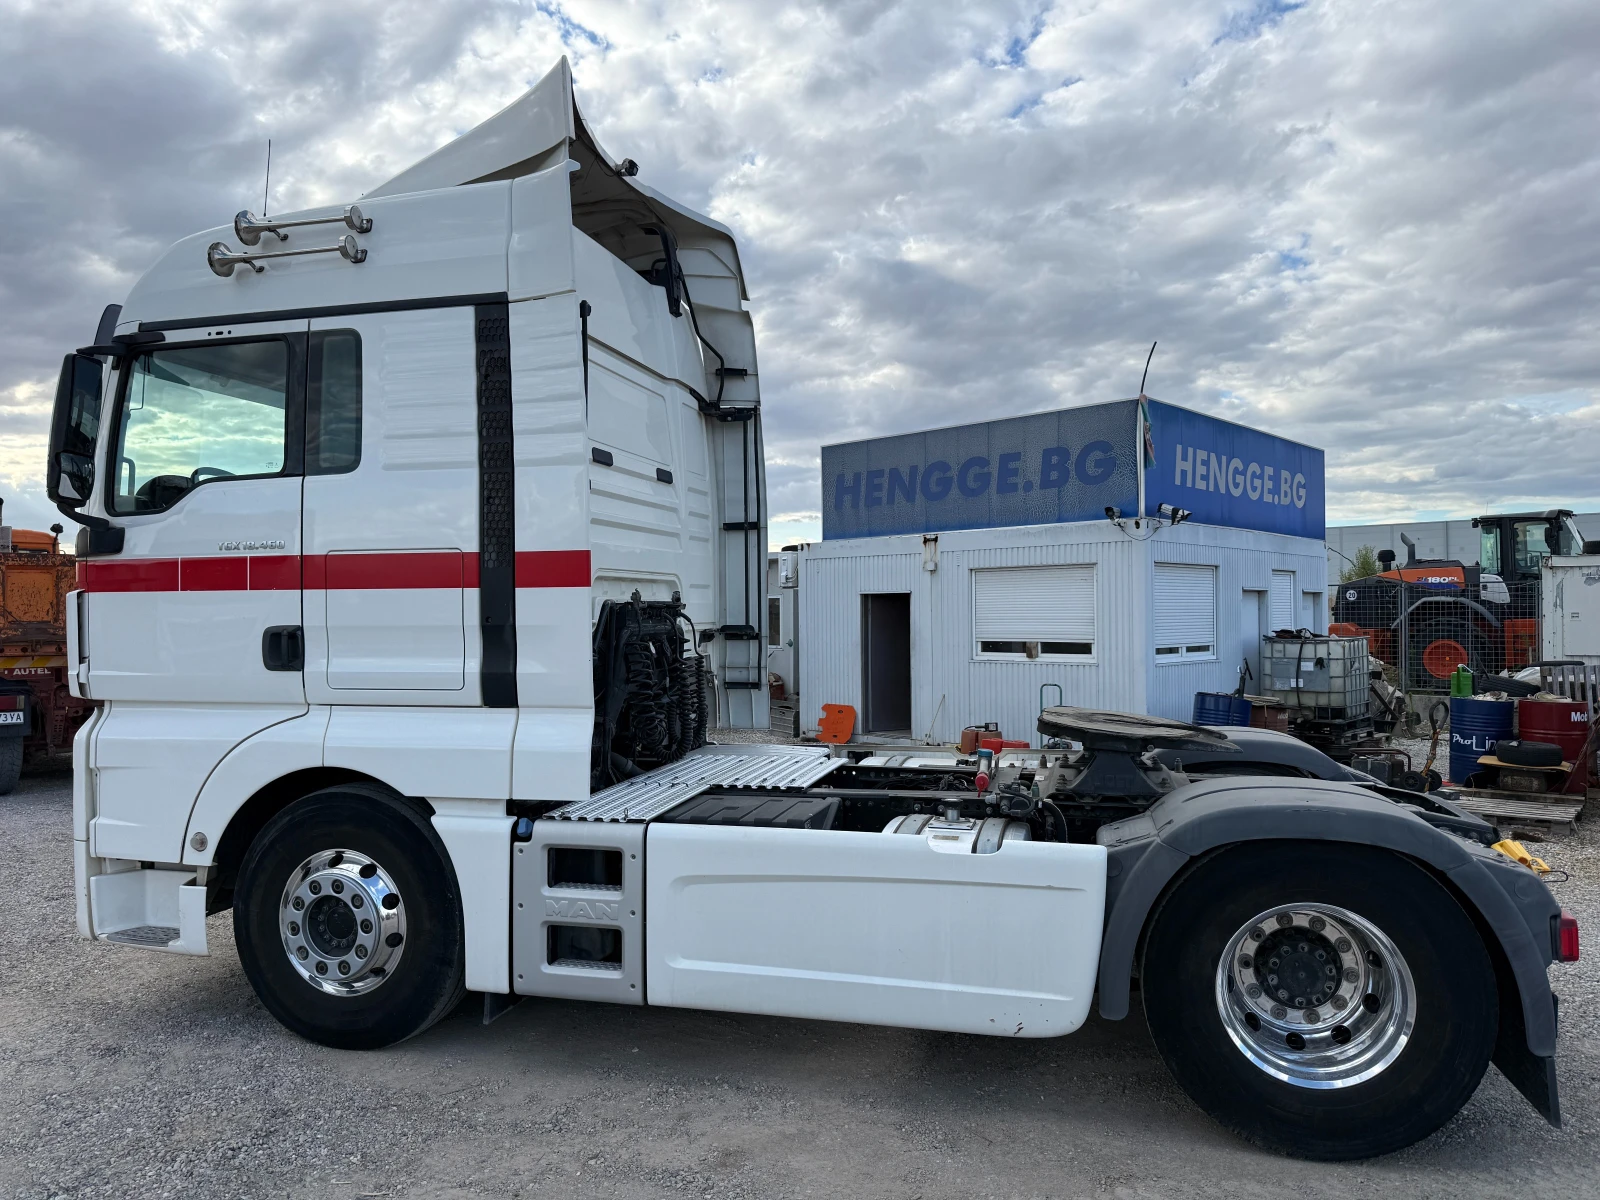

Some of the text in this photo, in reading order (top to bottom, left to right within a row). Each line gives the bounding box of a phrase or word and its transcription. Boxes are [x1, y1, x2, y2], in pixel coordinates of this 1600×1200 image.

[834, 440, 1117, 511] HENGGE.BG
[1175, 444, 1306, 508] HENGGE.BG
[218, 540, 285, 551] TGX 18.460
[13, 667, 51, 676] AUTEL
[545, 899, 619, 921] MAN
